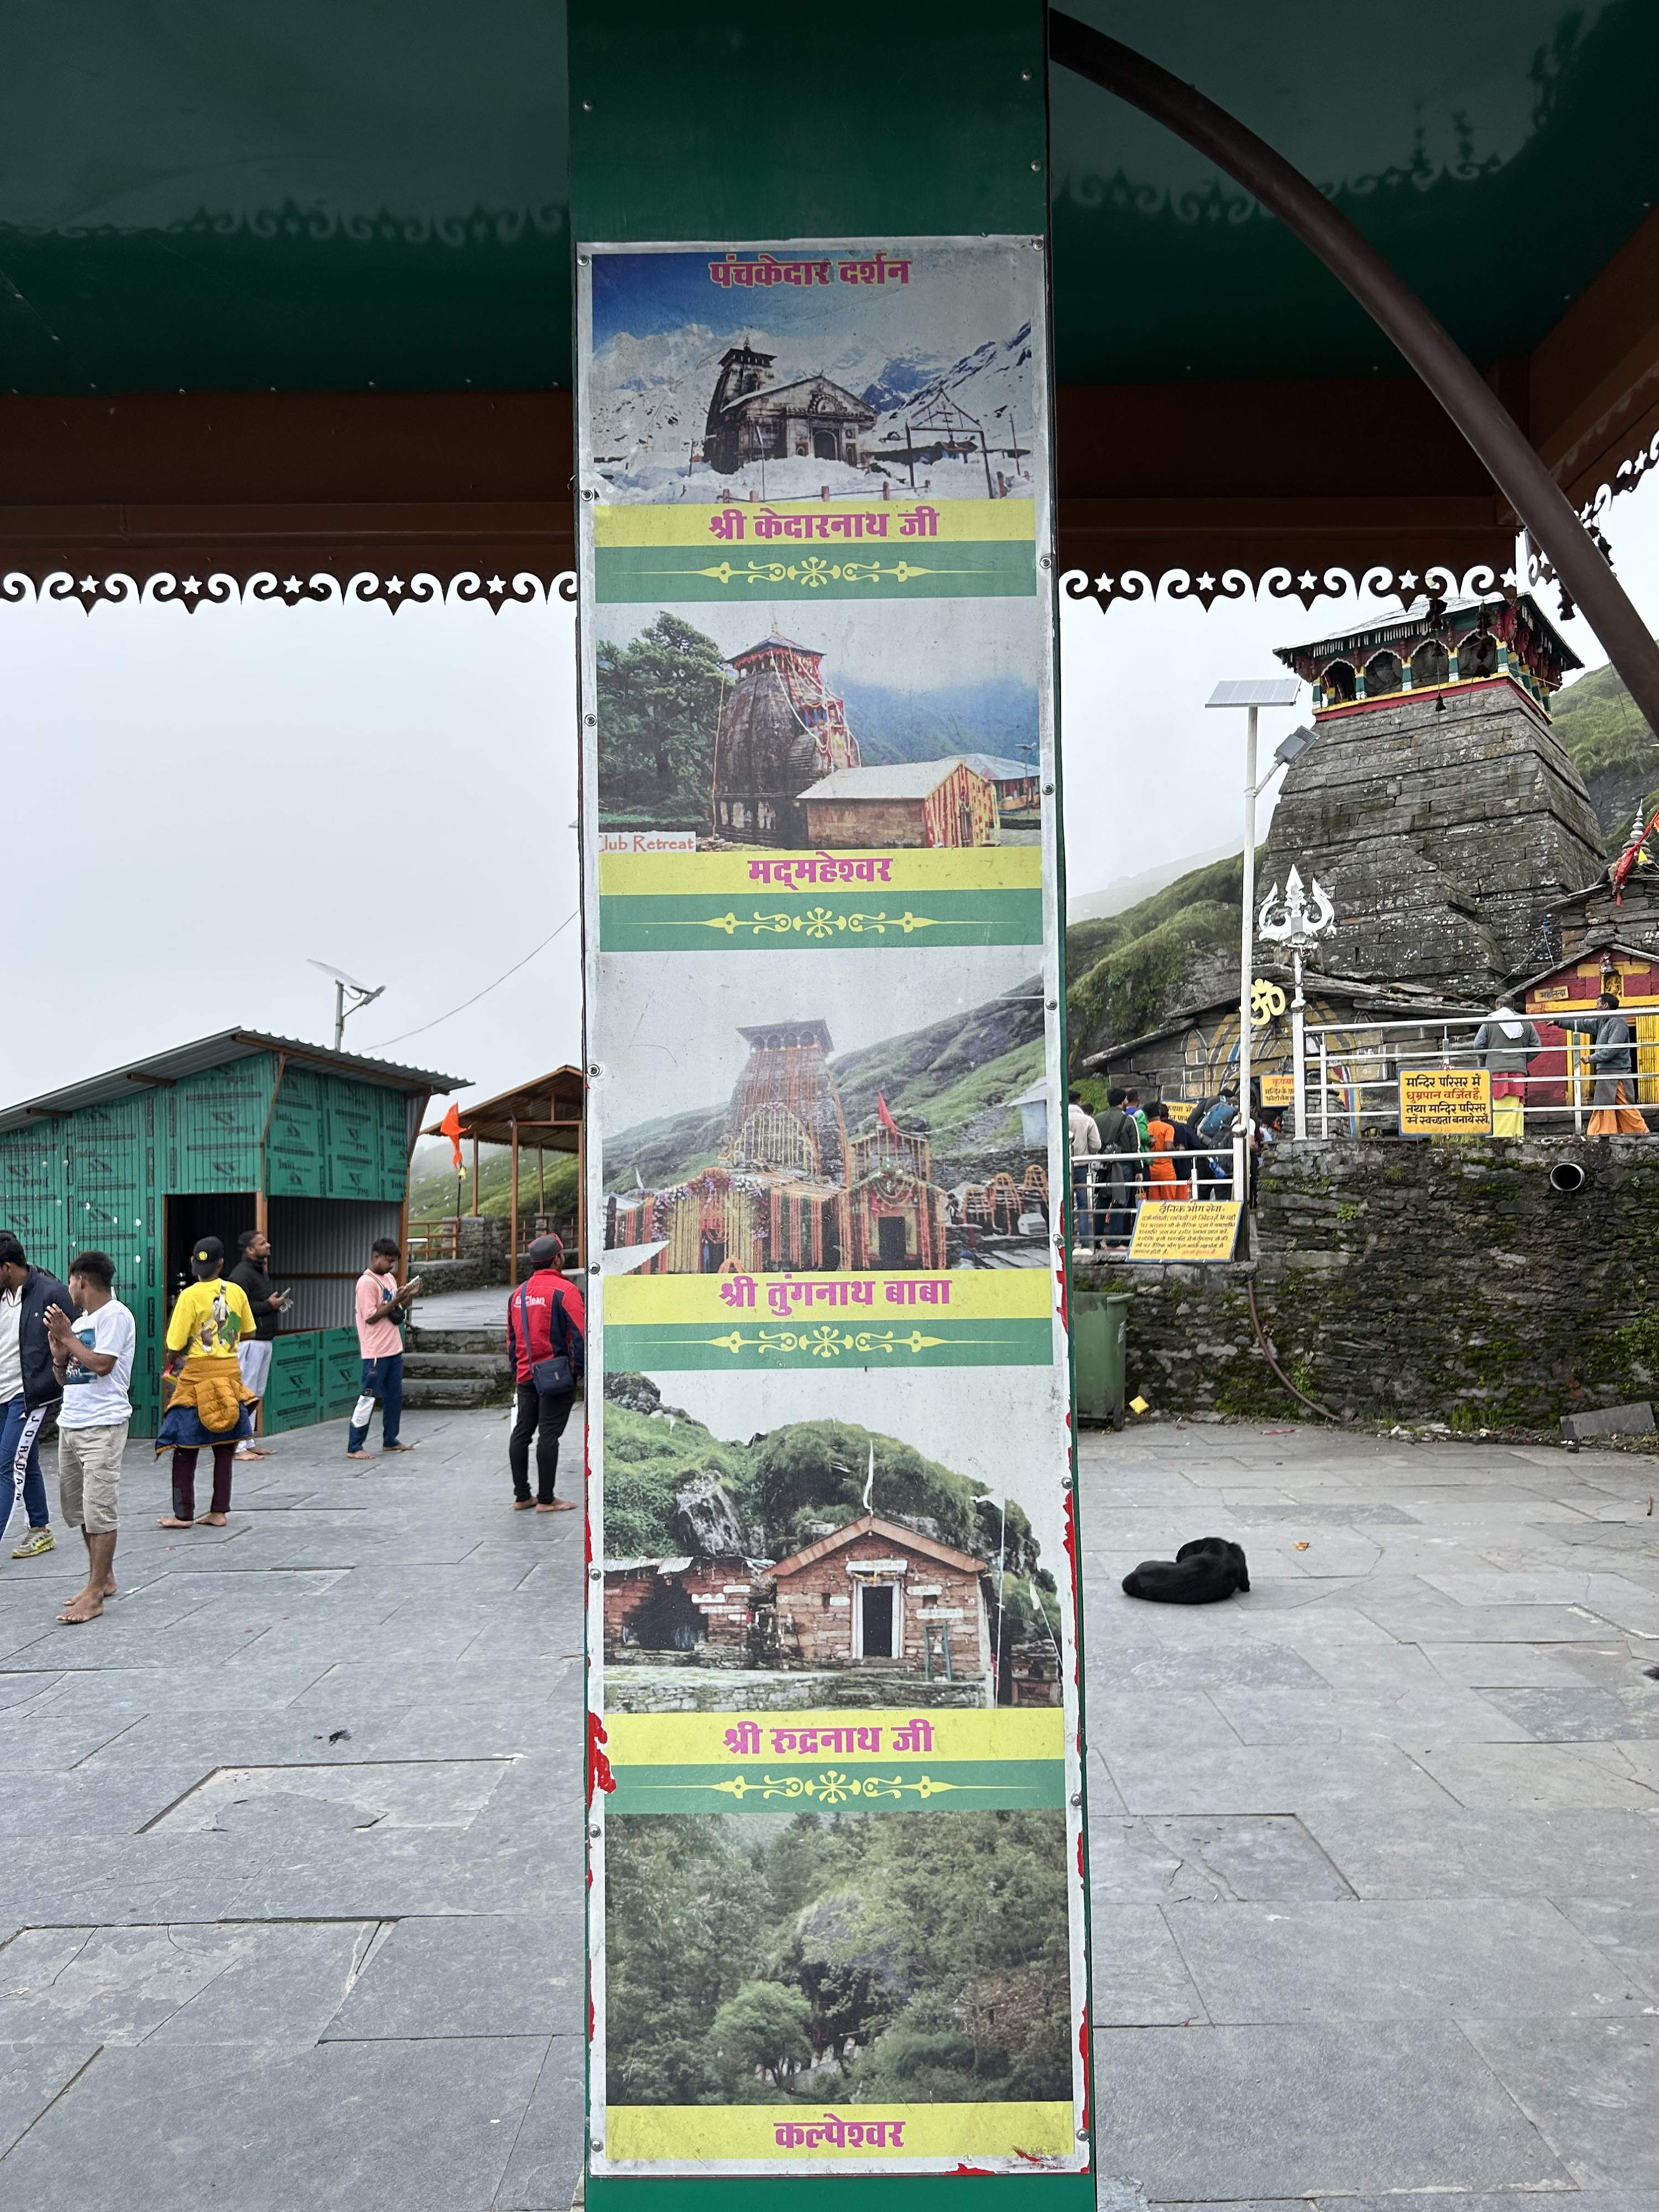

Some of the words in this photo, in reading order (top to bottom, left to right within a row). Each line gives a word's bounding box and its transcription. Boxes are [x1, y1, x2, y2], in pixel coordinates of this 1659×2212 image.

[709, 253, 832, 287] पंचकेदार
[838, 252, 912, 285] दर्शन
[708, 509, 747, 539] श्री
[753, 508, 890, 539] केदारनाथ
[898, 505, 940, 536] जी
[633, 835, 694, 852] Retreat
[1405, 1074, 1436, 1088] मन्दिर
[1438, 1074, 1468, 1088] परिसर
[1471, 1073, 1481, 1087] में
[1443, 1088, 1472, 1099] वर्जित
[1405, 1113, 1418, 1125] में
[1406, 1104, 1427, 1114] तथा
[1428, 1101, 1457, 1115] मन्दिर
[1458, 1100, 1486, 1113] परिसर
[719, 1275, 759, 1307] श्री
[766, 1274, 876, 1317] तुंगनाथ
[883, 1280, 953, 1305] बाबा
[15, 1415, 40, 1501] JORDAN
[723, 1720, 763, 1754] श्री
[769, 1726, 883, 1755] रुद्रनाथ
[890, 1718, 935, 1752] जी
[773, 2112, 906, 2148] कल्पेश्वर
